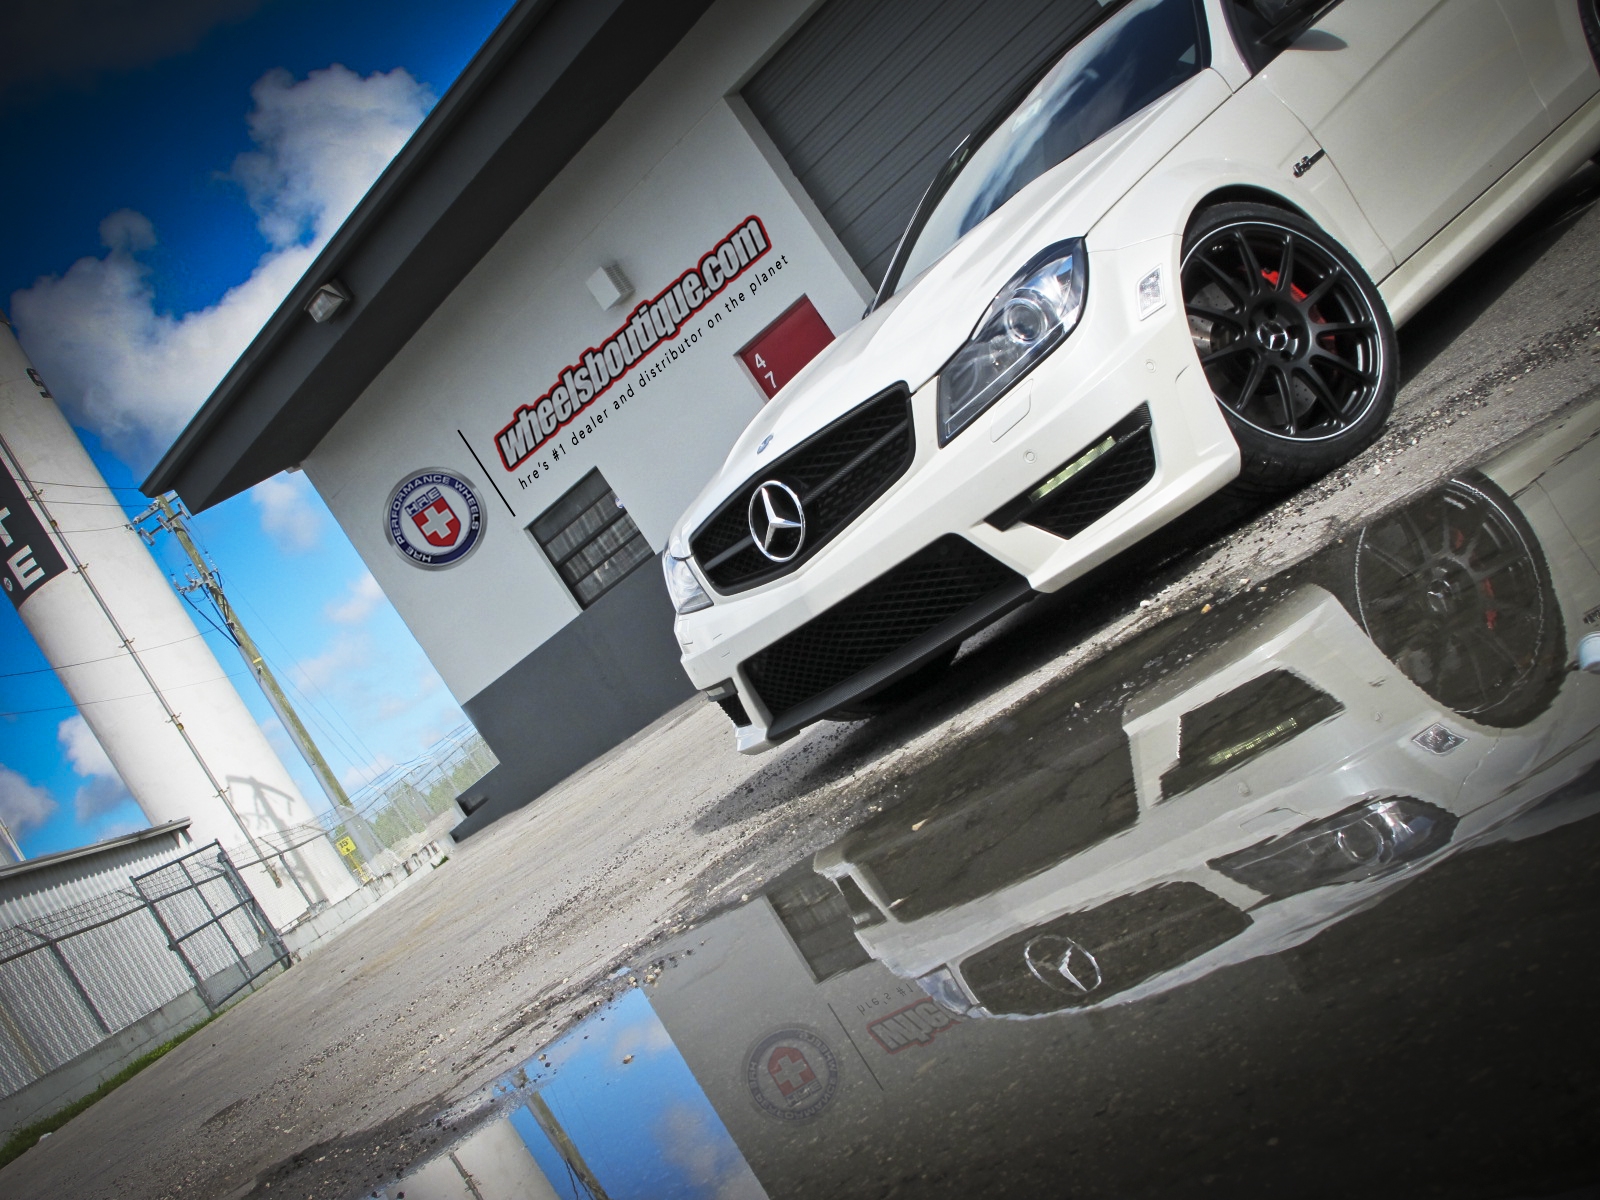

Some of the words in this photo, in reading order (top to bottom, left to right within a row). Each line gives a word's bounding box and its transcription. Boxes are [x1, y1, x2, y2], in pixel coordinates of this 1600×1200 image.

[496, 217, 771, 470] wheelsboutique.com
[518, 461, 550, 490] hre's
[552, 443, 566, 462] #1
[571, 408, 609, 446] dealer
[613, 384, 635, 410] and
[638, 328, 703, 388] distributor
[707, 312, 723, 329] on
[725, 292, 746, 313] the
[749, 254, 789, 295] planet
[391, 474, 451, 545] PERFORMANCE
[404, 486, 443, 517] HRE
[454, 481, 480, 530] WHEELS
[405, 546, 432, 563] HRE
